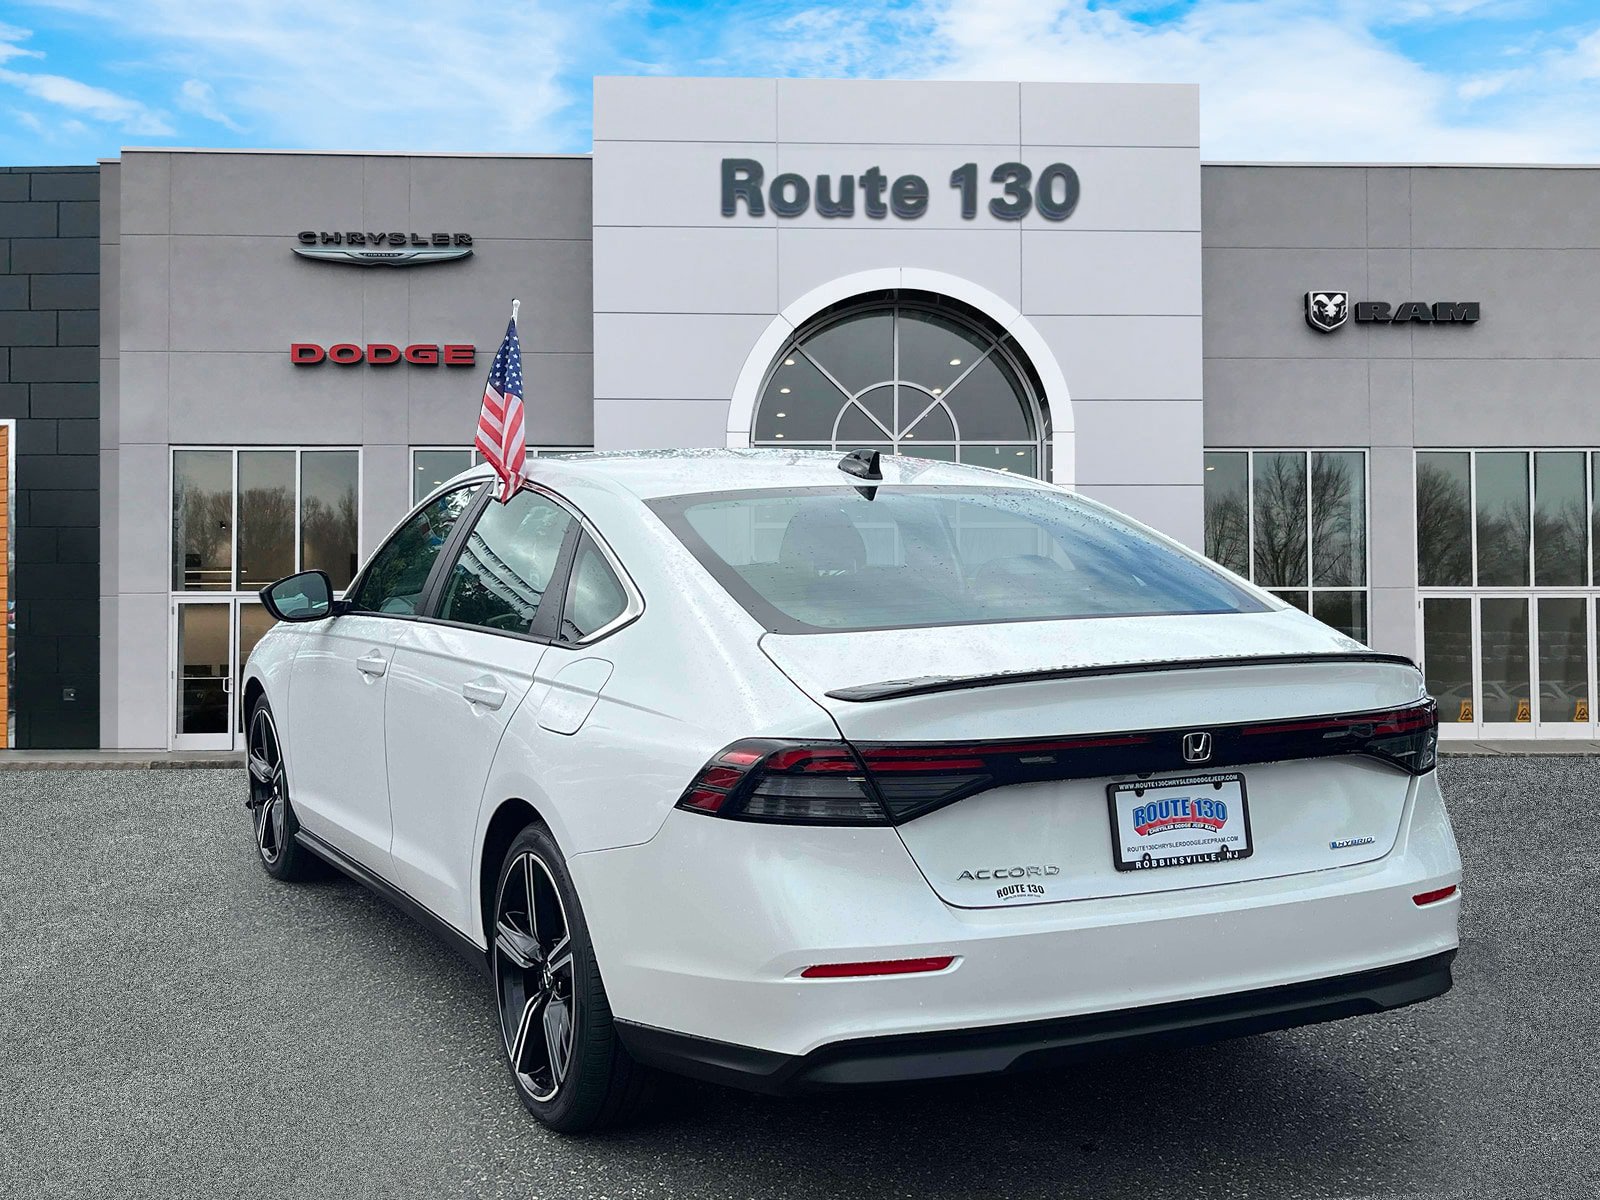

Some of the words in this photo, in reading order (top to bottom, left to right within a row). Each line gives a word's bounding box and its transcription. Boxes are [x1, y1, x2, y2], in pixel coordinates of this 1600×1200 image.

[720, 158, 929, 217] Route
[950, 162, 1080, 221] 130
[298, 231, 473, 245] CHRYSLER
[1355, 302, 1480, 324] RAM
[291, 343, 476, 367] DODGE
[1133, 797, 1191, 827] ROUTE
[1194, 798, 1227, 822] 130
[1337, 836, 1373, 848] HYBRID
[1135, 853, 1222, 869] ROBBINSVILLE,
[1226, 850, 1239, 859] NJ
[957, 865, 1060, 880] ACCORD
[996, 884, 1026, 898] ROUTE
[1027, 884, 1045, 894] 130
